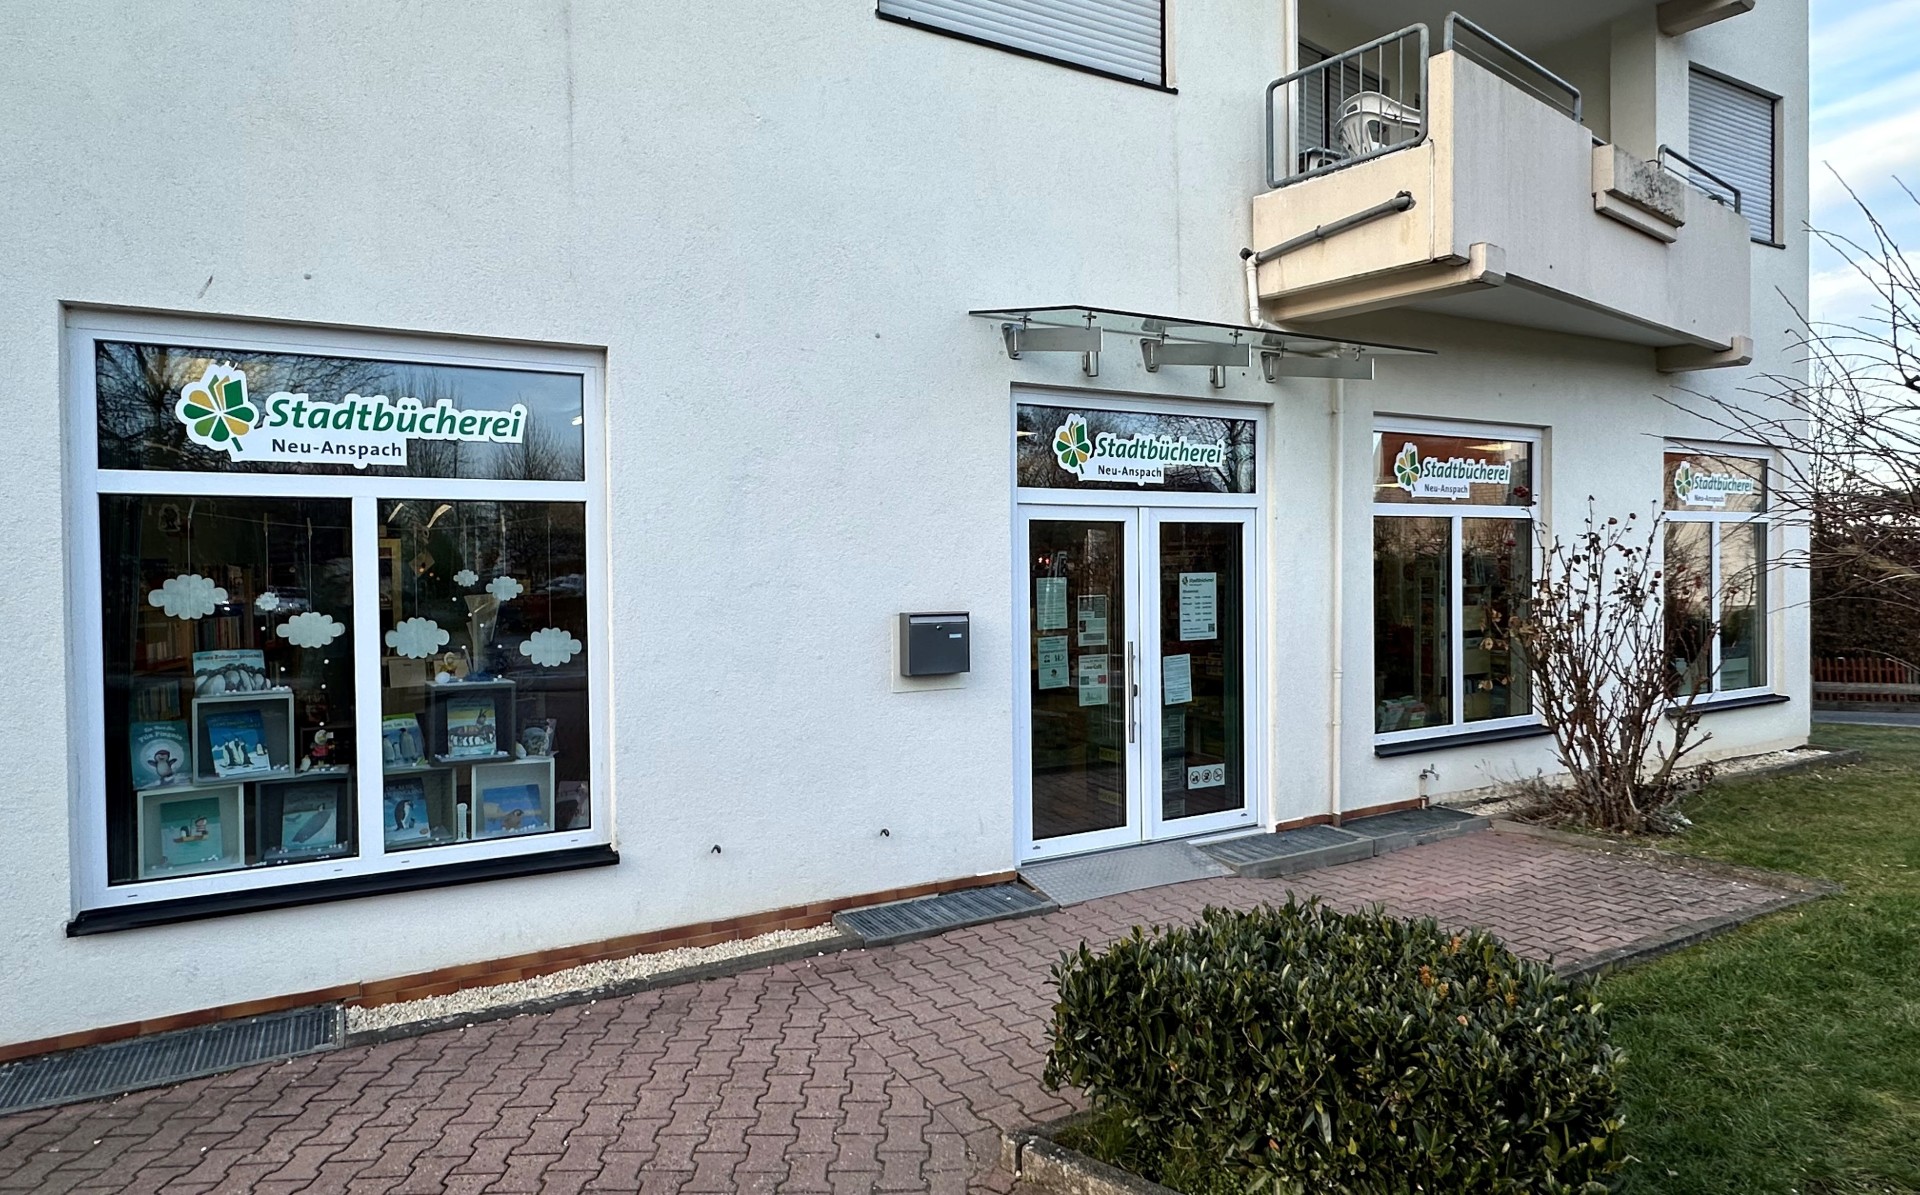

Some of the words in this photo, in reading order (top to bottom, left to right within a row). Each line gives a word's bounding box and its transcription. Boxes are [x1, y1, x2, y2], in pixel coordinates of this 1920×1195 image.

[269, 399, 522, 438] Stadtbücherei
[271, 438, 402, 460] Neu-Anspach
[1097, 437, 1222, 463] Stadtbücherei
[1097, 465, 1162, 479] Neu-Anspach
[1424, 461, 1509, 480] Stadtbücherei
[1424, 484, 1468, 495] Neu-Anspach
[1694, 476, 1753, 492] Stadtbücherei
